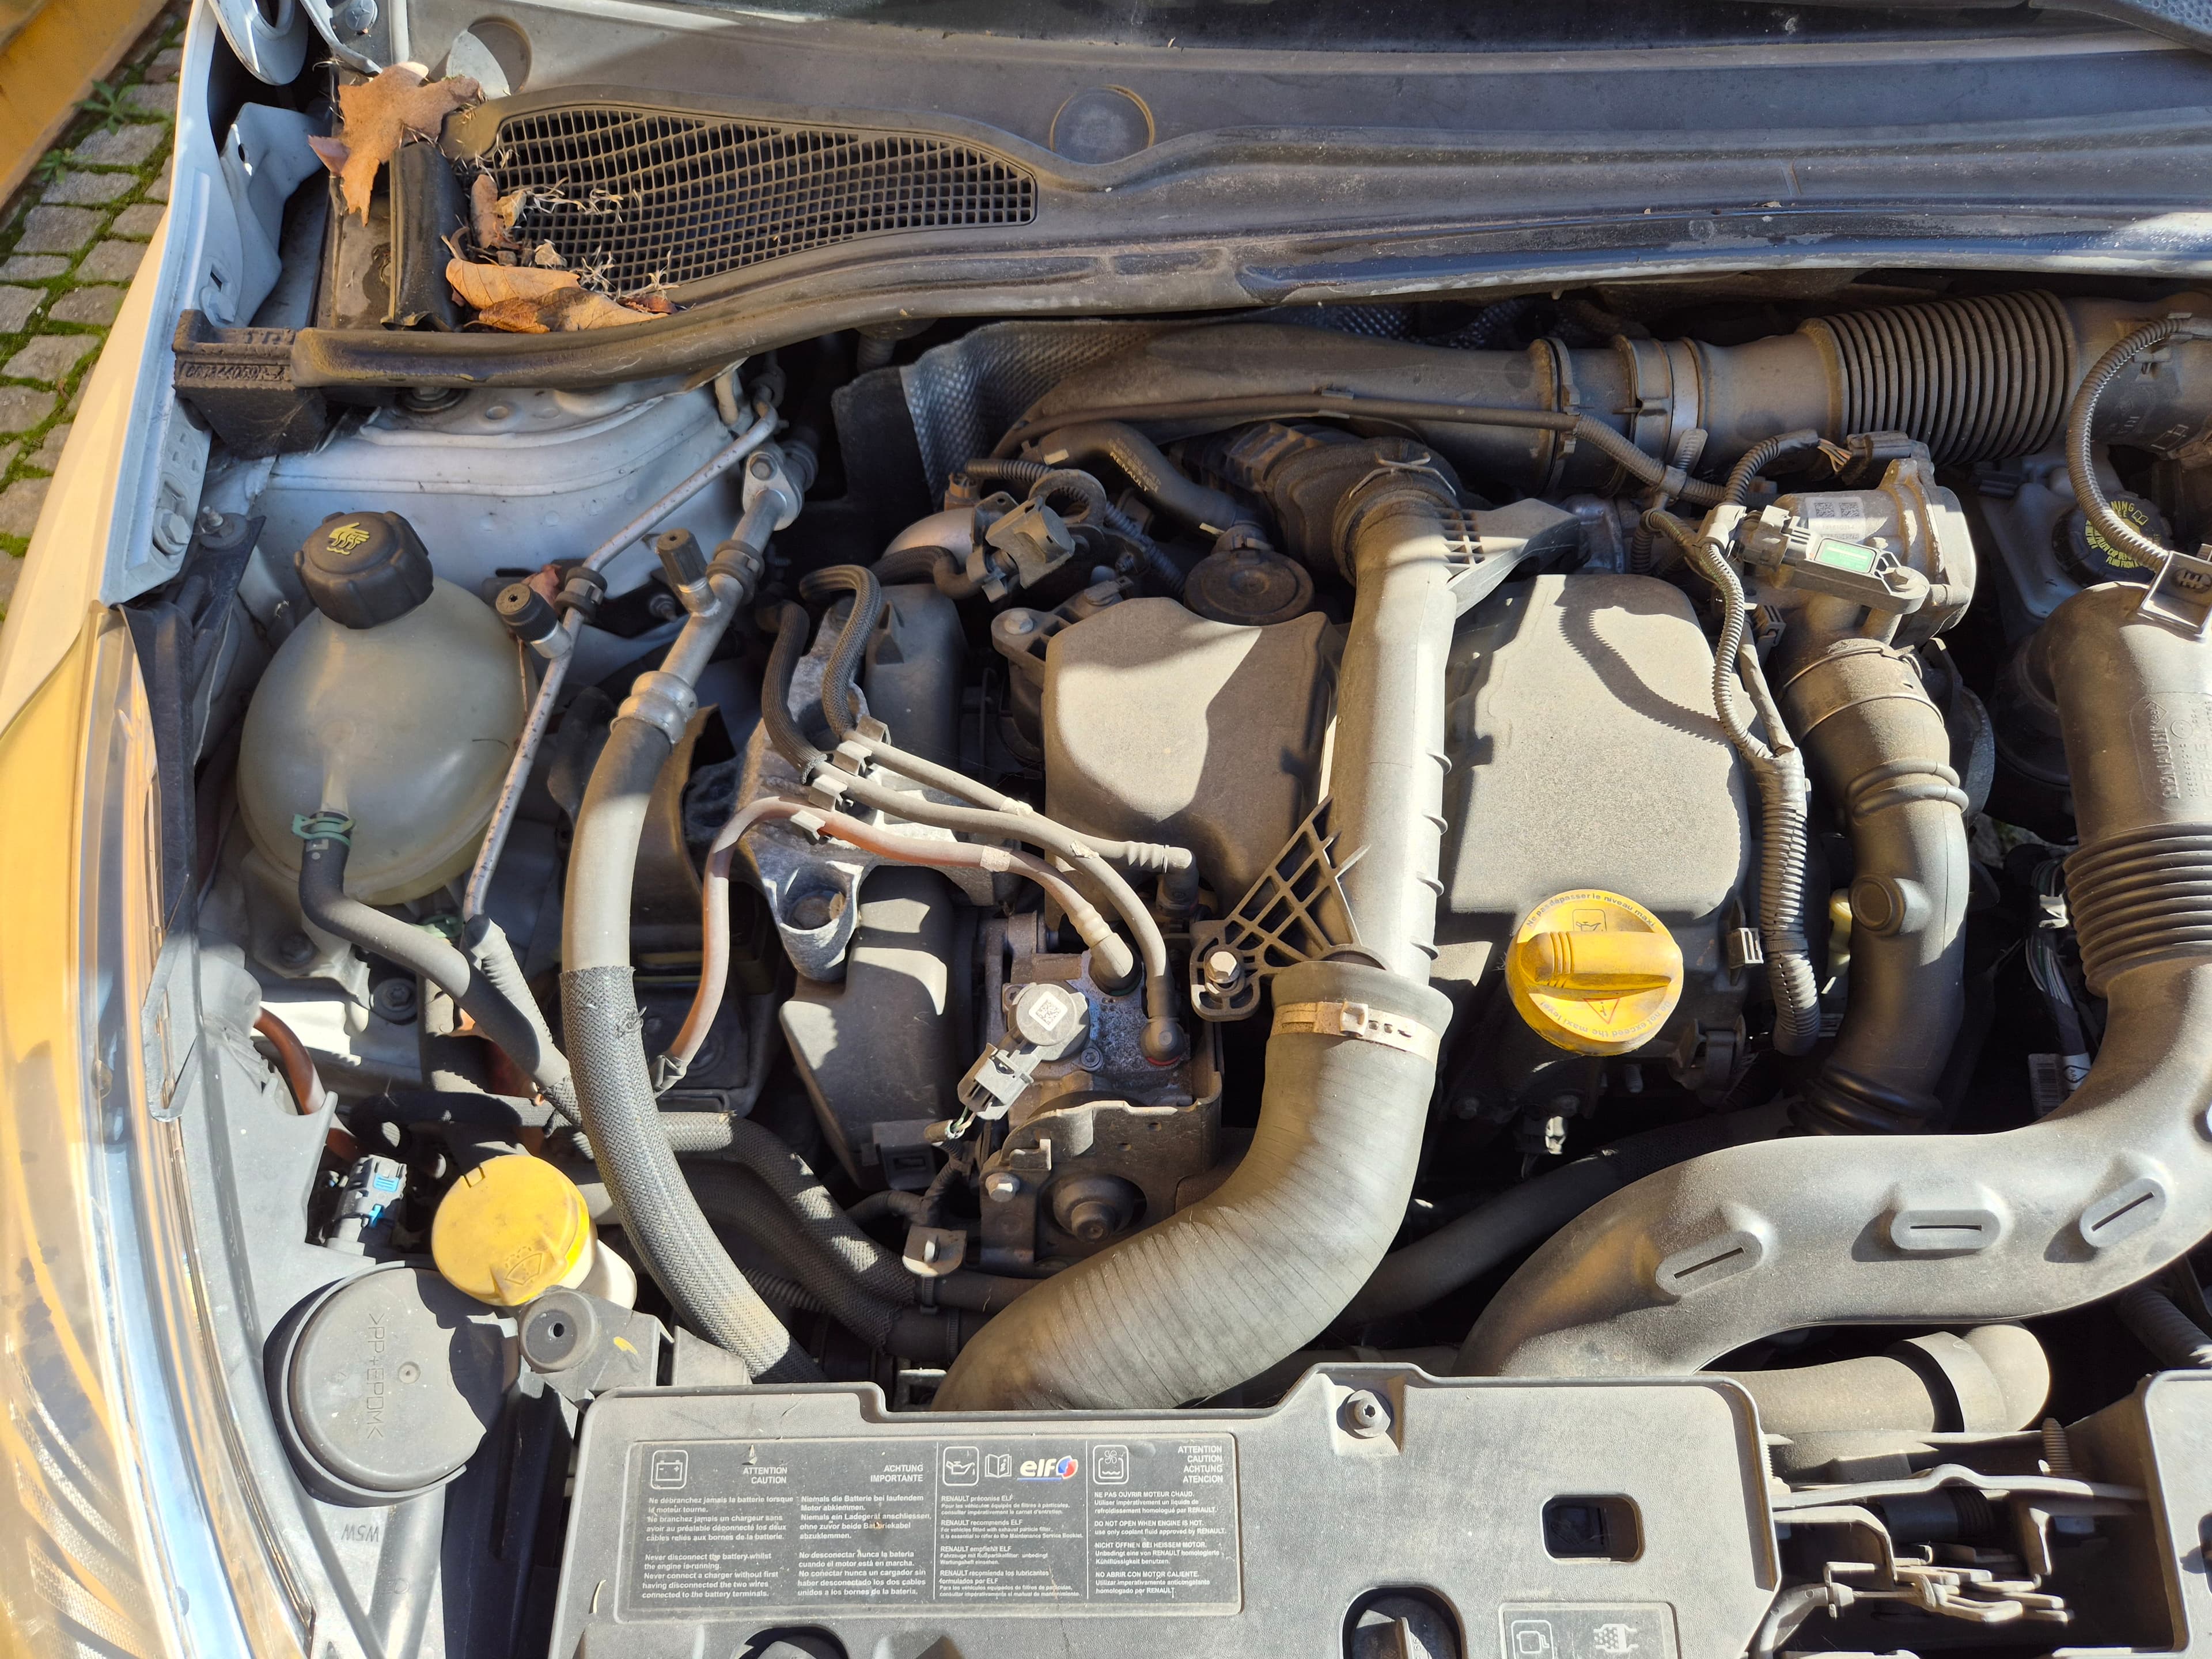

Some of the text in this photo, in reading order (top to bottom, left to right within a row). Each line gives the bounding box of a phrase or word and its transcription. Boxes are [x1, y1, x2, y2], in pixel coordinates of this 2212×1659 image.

[1109, 452, 1149, 491] RENAULT
[2111, 501, 2135, 513] NING
[2149, 726, 2180, 798] RENAULT
[1527, 915, 1537, 926] Ne
[1536, 904, 1550, 917] pas
[1604, 896, 1633, 910] niveau
[1634, 910, 1656, 927] maxi
[1540, 1001, 1562, 1021] level
[1647, 1011, 1660, 1025] not
[1563, 1018, 1588, 1033] maxi
[1592, 1029, 1608, 1037] the
[1612, 1022, 1646, 1037] exceed
[1020, 1459, 1056, 1476] elf
[341, 1524, 379, 1543] W5W
